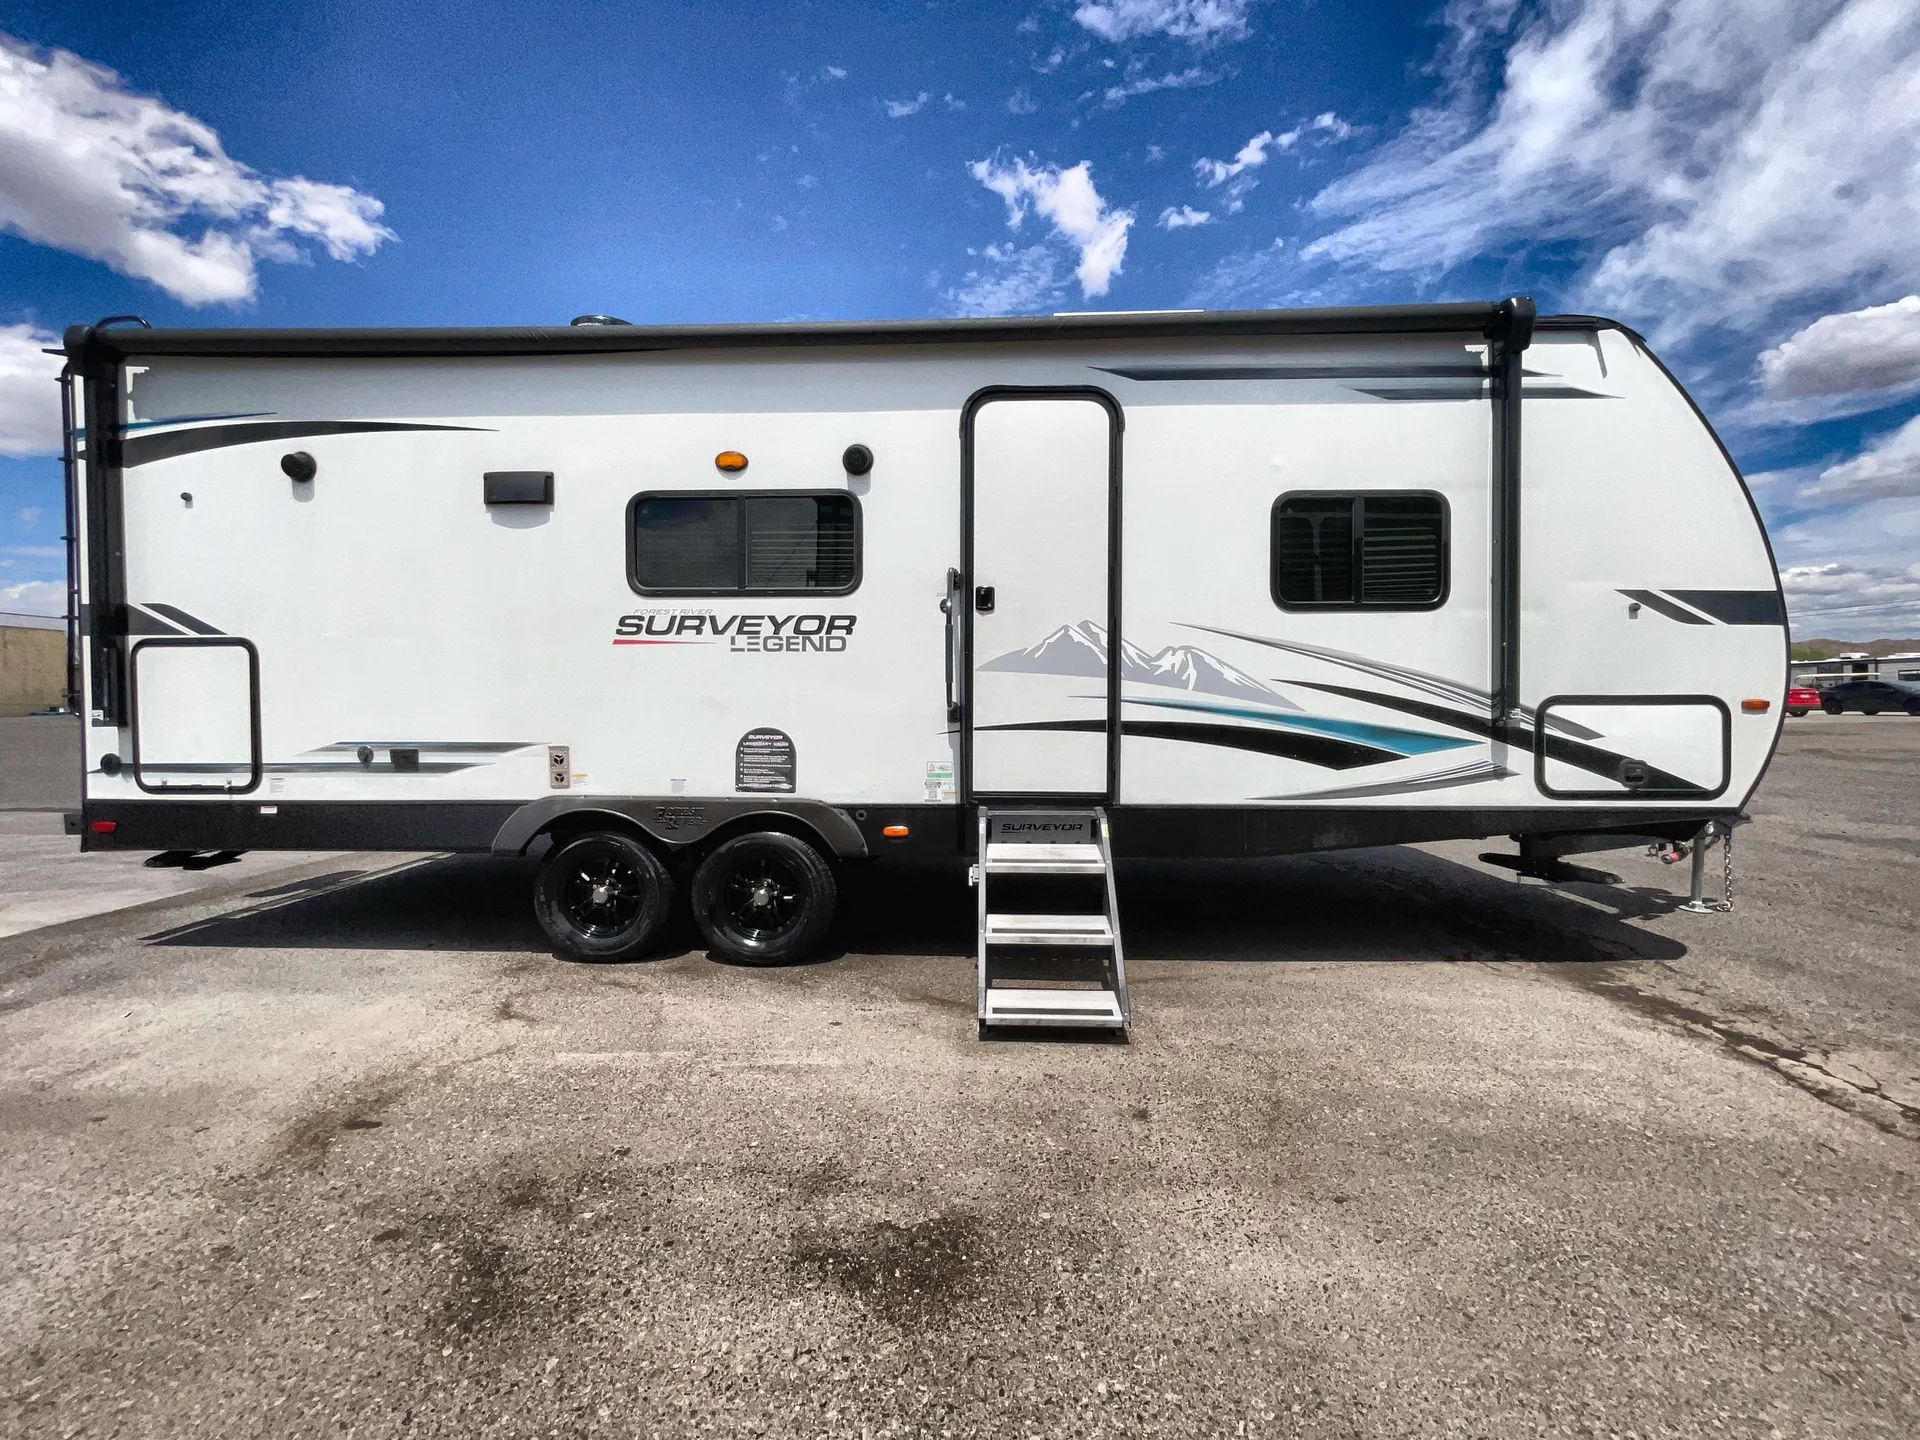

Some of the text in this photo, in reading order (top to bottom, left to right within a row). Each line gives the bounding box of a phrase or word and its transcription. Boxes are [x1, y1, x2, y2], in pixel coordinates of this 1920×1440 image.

[615, 615, 857, 636] SURVEYOR
[730, 635, 848, 653] LEGEND
[1000, 823, 1084, 831] SURVEYOR
